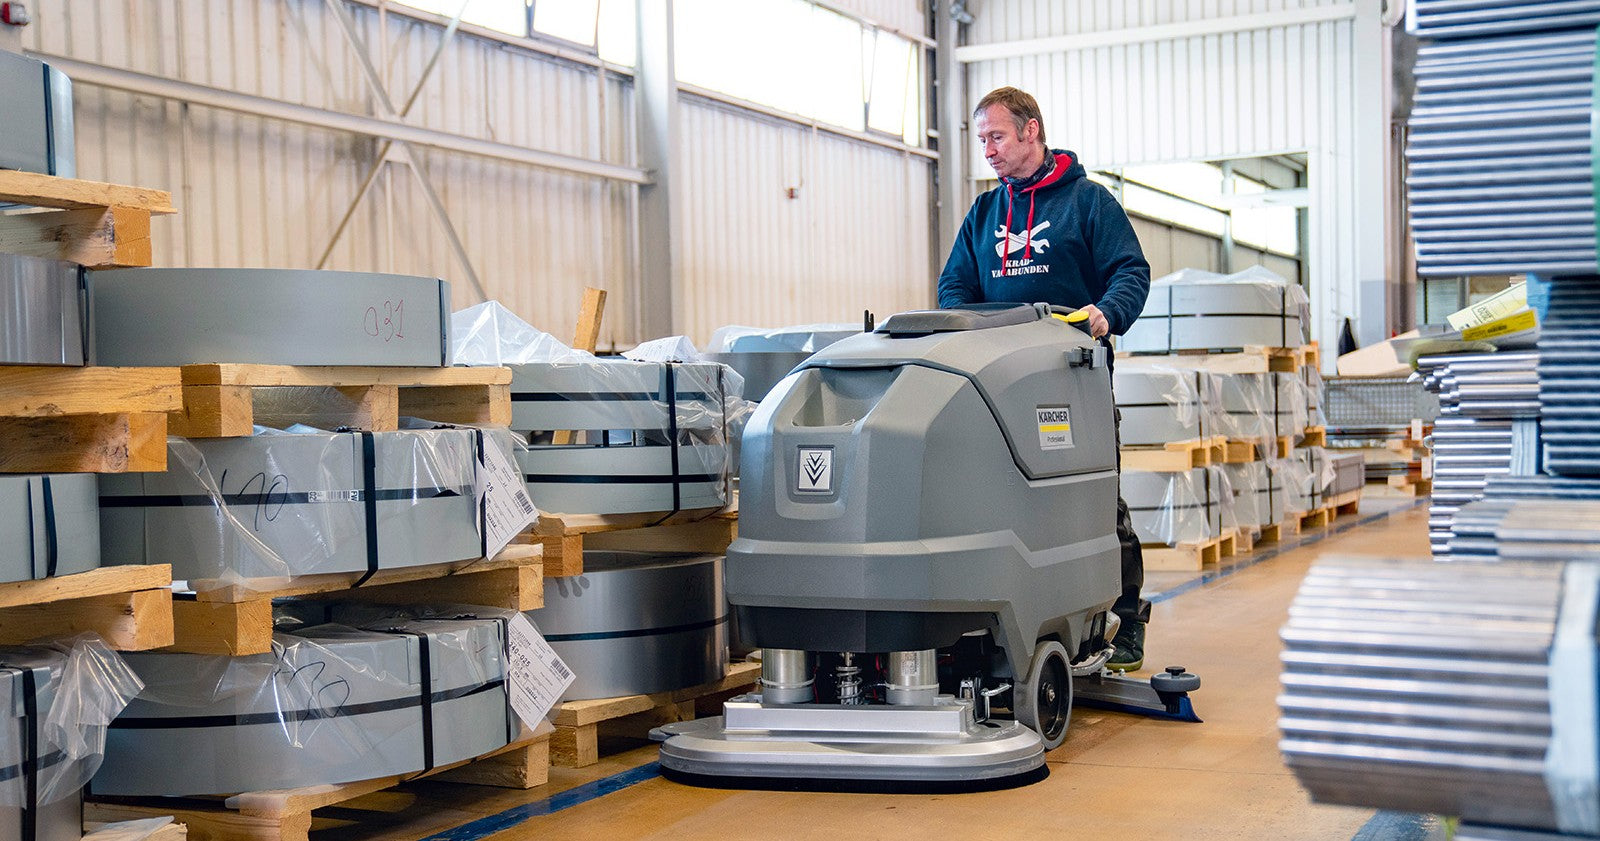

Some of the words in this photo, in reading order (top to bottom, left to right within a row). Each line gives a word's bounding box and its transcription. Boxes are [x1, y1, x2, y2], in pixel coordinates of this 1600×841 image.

[1006, 259, 1034, 268] KRAD-
[991, 264, 1050, 278] VAABUNDEN
[363, 299, 404, 343] 031
